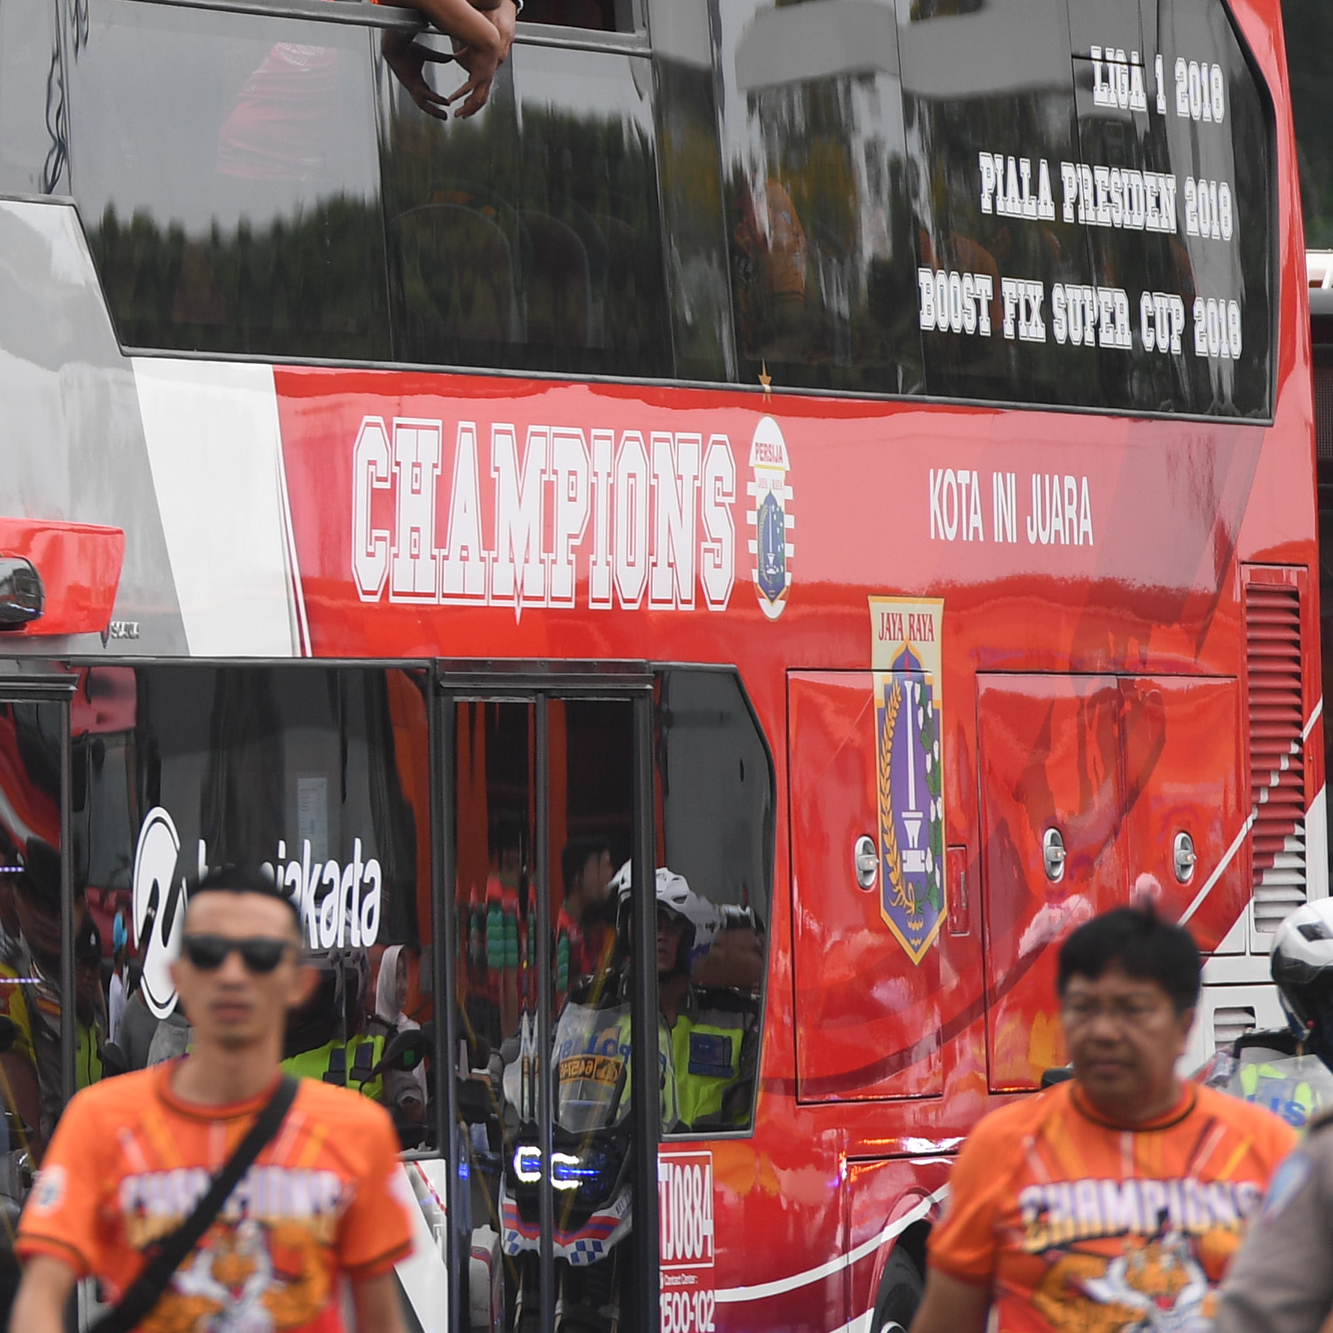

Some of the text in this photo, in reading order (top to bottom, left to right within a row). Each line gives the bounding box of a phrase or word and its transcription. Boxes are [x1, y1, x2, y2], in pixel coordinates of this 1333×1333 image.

[1090, 45, 1225, 124] LIGA 1 2018
[979, 152, 1233, 241] PIALA PRESIDEN 2018
[917, 267, 1243, 360] BOOST FIX SUPER CUP 2018
[351, 414, 735, 622] CHAMPIONS
[928, 467, 1095, 547] KOTA INI JUARA
[878, 612, 935, 642] JAYA RAYA
[659, 1289, 715, 1333] 1500-102
